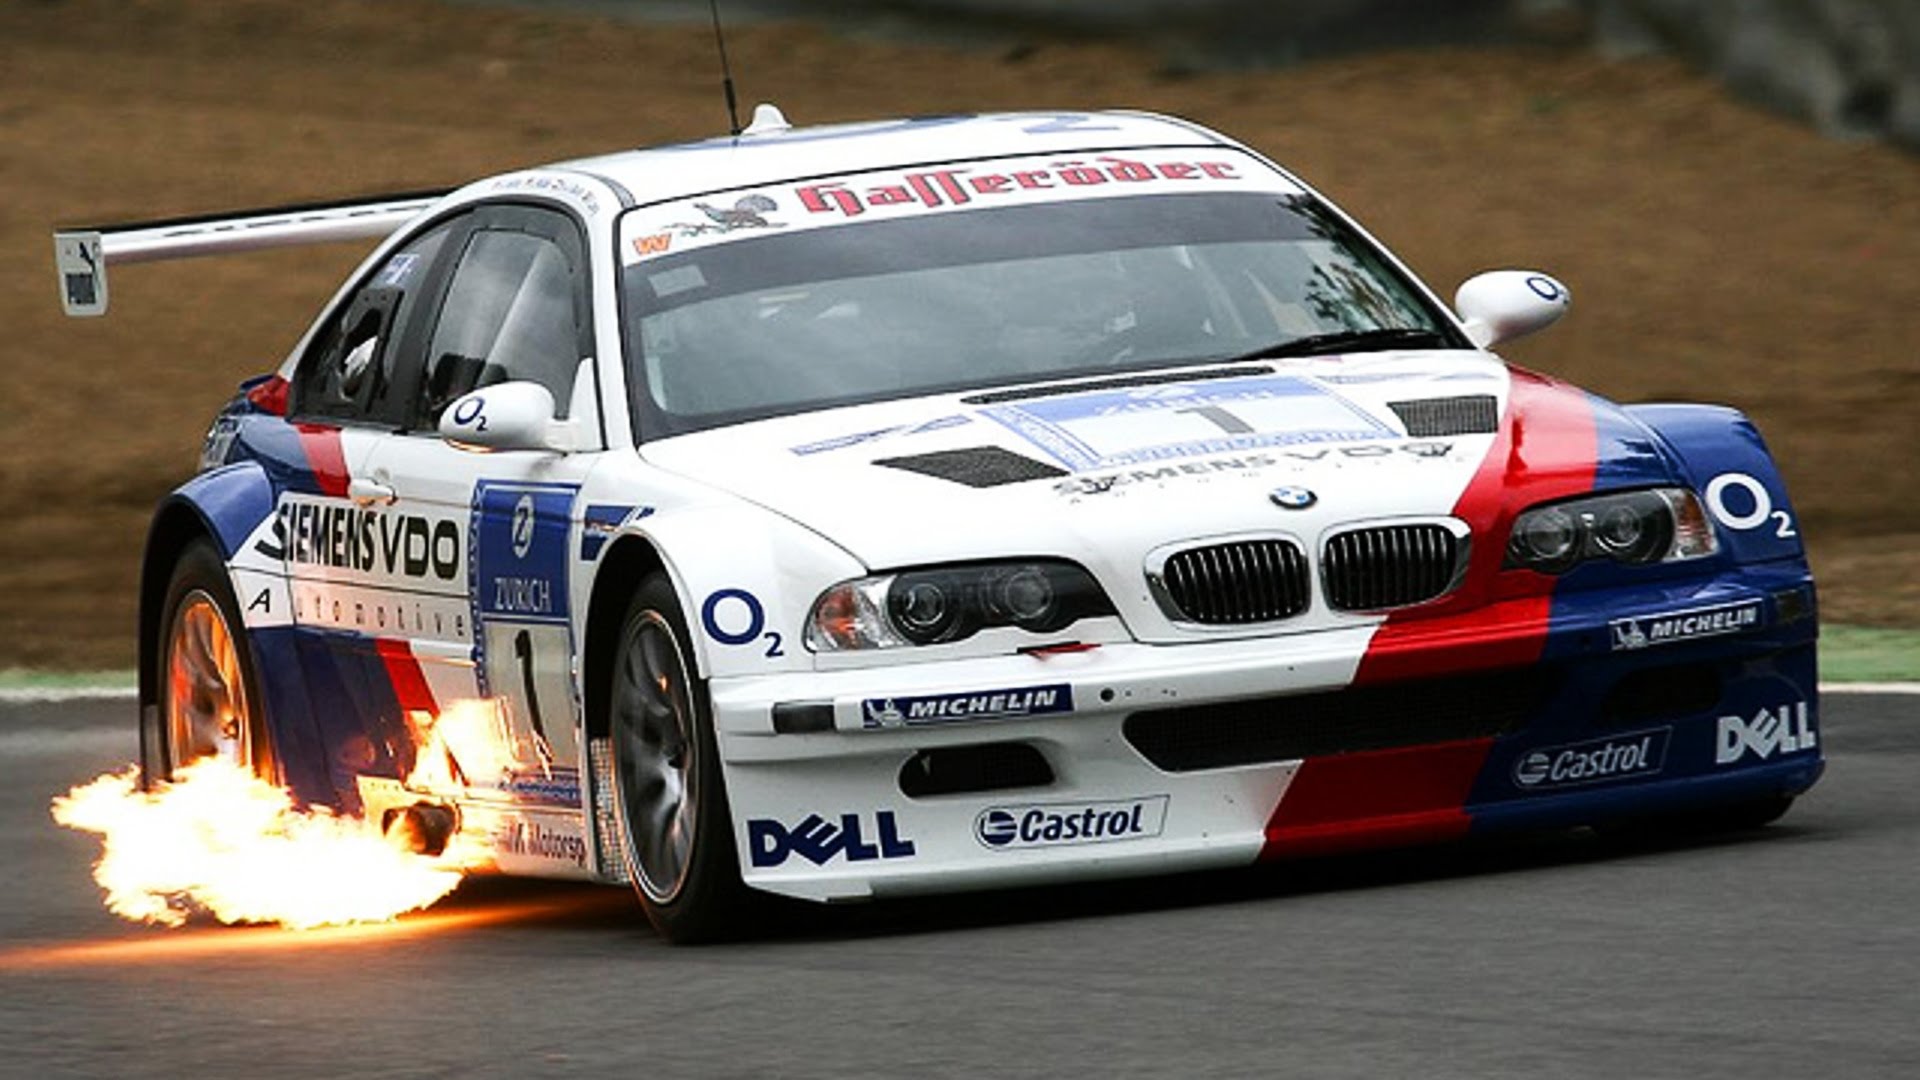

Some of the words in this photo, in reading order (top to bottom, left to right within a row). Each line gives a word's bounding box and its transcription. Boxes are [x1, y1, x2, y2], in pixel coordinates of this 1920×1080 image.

[454, 396, 488, 431] O2
[1174, 404, 1256, 434] 1
[1705, 472, 1796, 537] O2
[254, 502, 377, 573] SIEMENS
[379, 513, 460, 580] VDO
[702, 588, 784, 657] O2
[1651, 605, 1758, 640] MICHELIN
[907, 687, 1058, 719] MICHELIN
[1715, 701, 1816, 764] DELL
[1550, 736, 1652, 782] Castrol
[747, 811, 916, 868] DELL
[1019, 804, 1144, 842] Castrol
